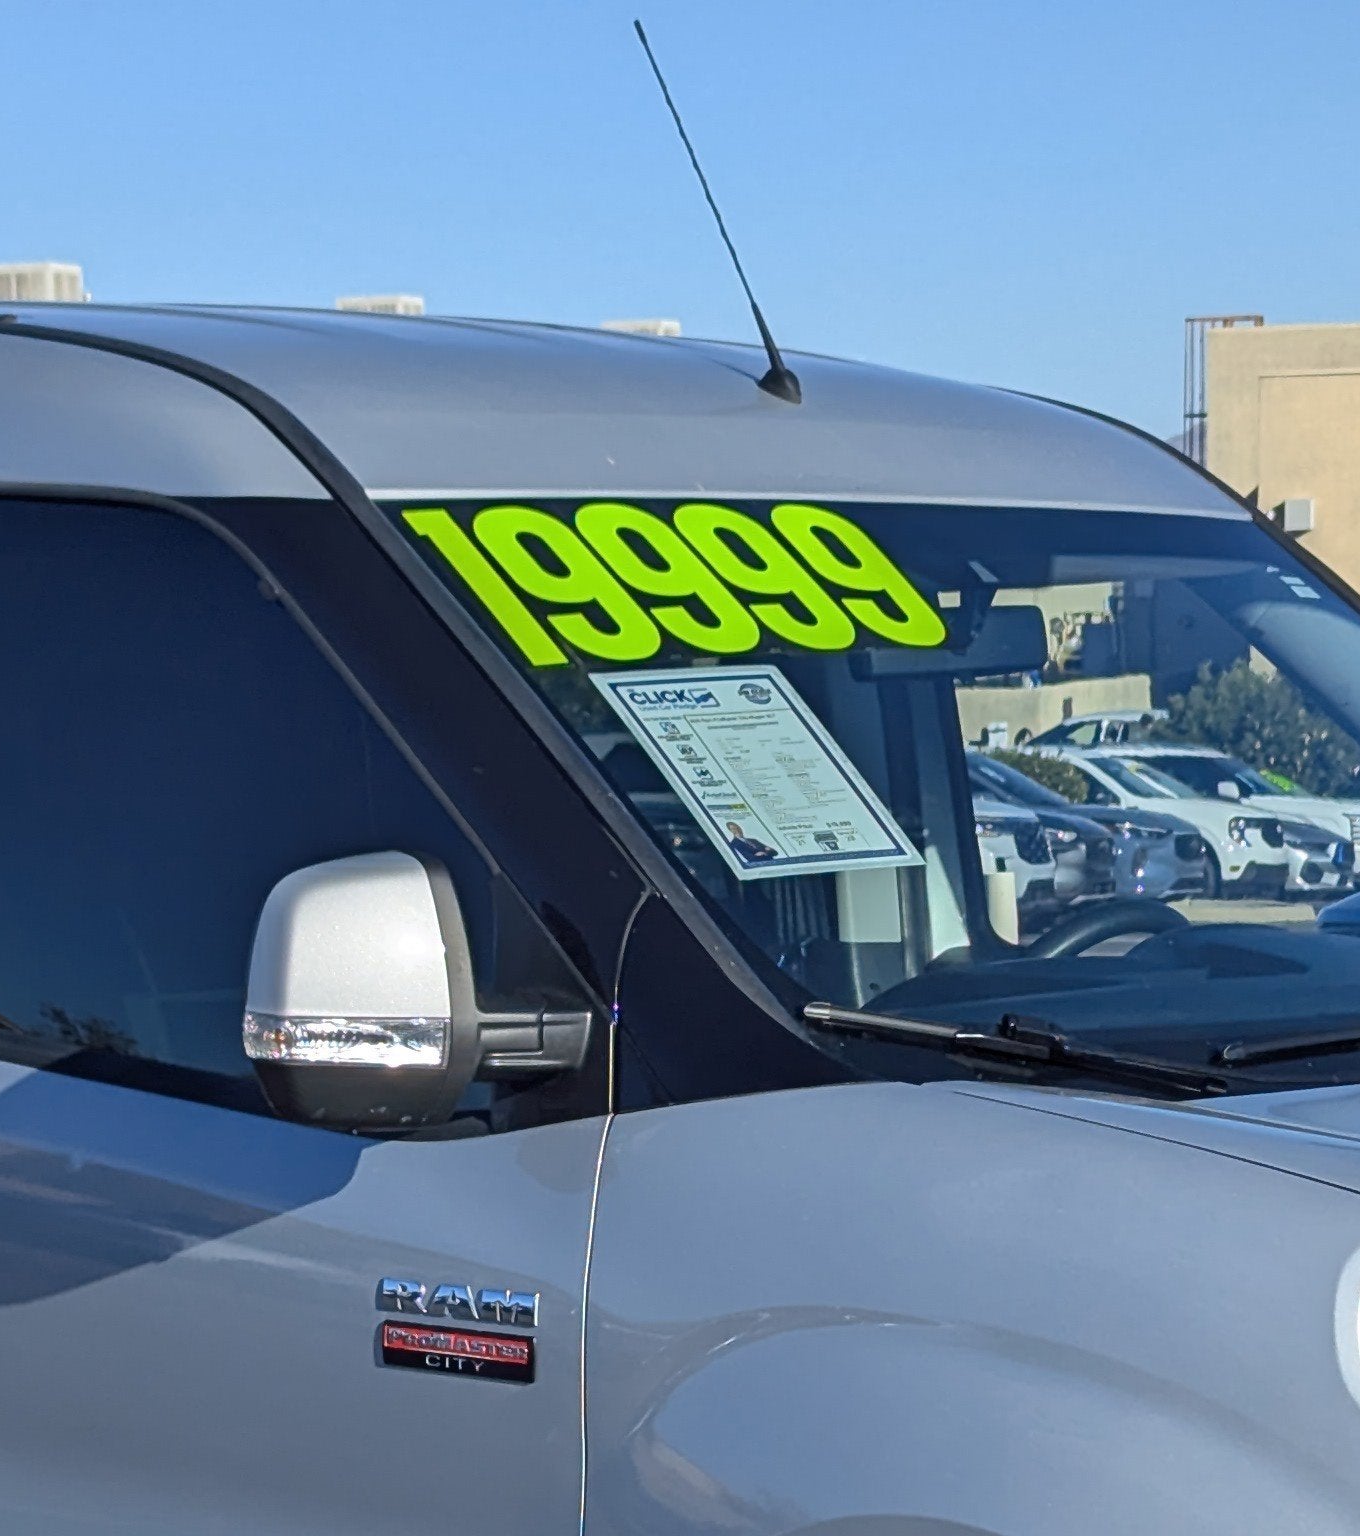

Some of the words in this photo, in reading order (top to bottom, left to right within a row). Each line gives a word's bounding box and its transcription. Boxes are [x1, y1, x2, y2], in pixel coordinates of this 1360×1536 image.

[402, 502, 946, 667] 19999
[629, 689, 692, 706] CLICK
[378, 1277, 540, 1327] RAM
[387, 1327, 528, 1360] PROMASTER
[425, 1354, 485, 1373] CITY
